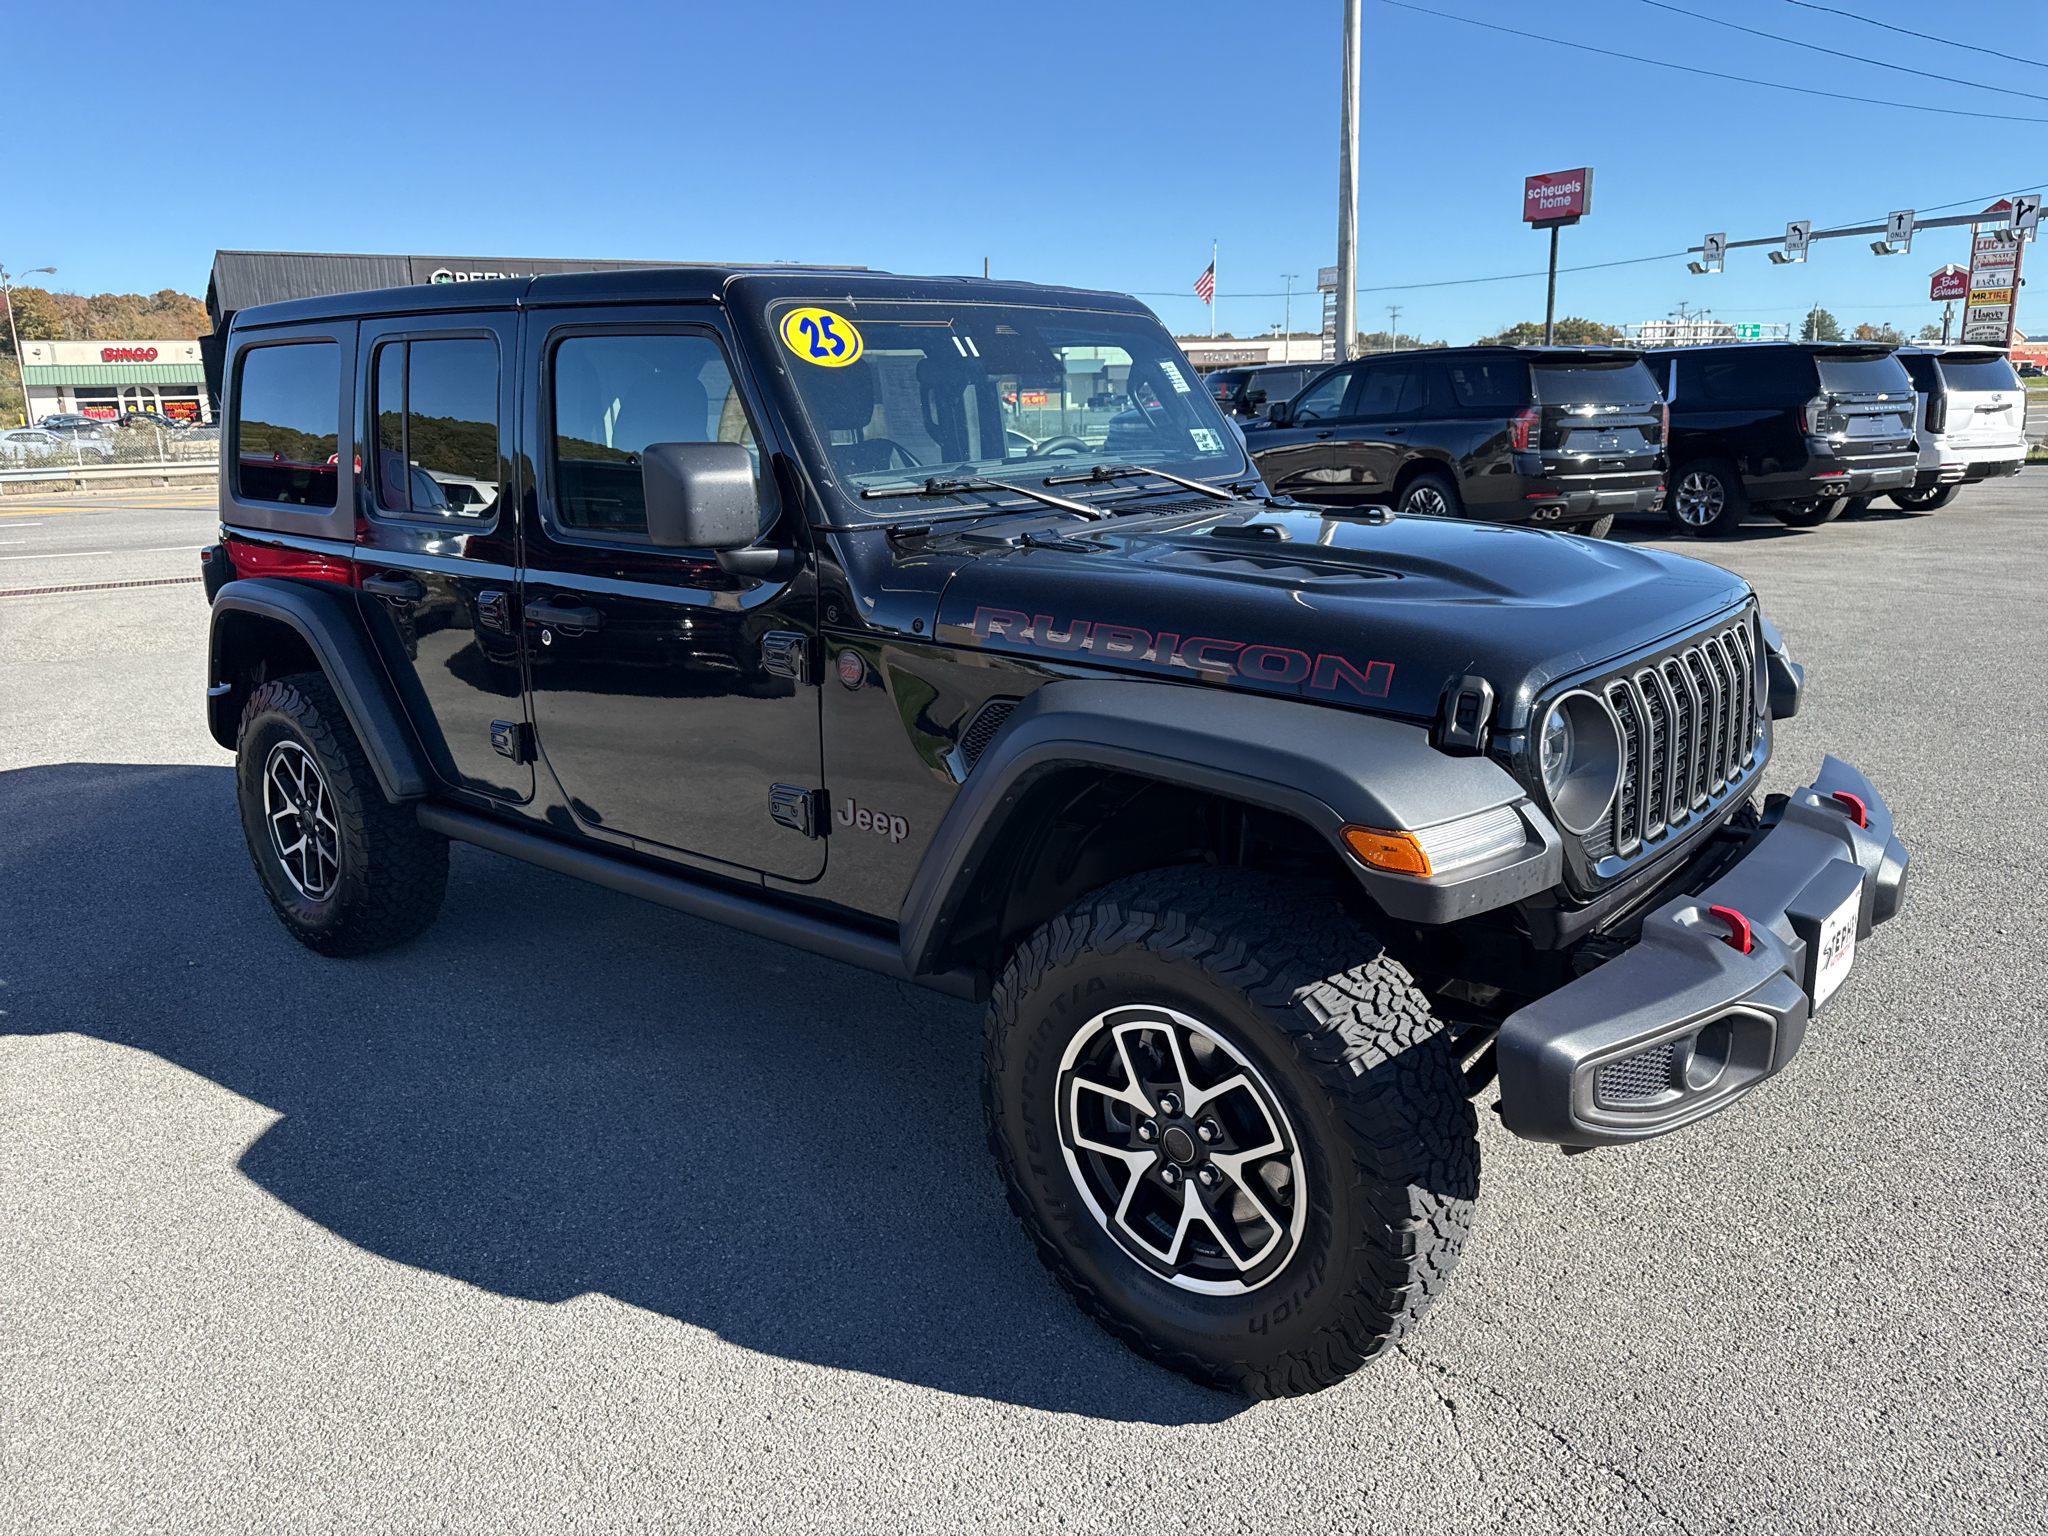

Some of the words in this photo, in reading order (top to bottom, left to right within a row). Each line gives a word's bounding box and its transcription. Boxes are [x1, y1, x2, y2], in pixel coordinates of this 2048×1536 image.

[1527, 180, 1581, 199] schewels
[1539, 195, 1571, 209] home
[1940, 276, 1960, 287] Bob
[1933, 286, 1964, 297] Evans
[799, 315, 846, 358] 25
[102, 347, 158, 361] BINGO
[83, 408, 116, 419] BINGO
[971, 606, 1396, 698] RUBICON
[837, 798, 910, 844] Jeep
